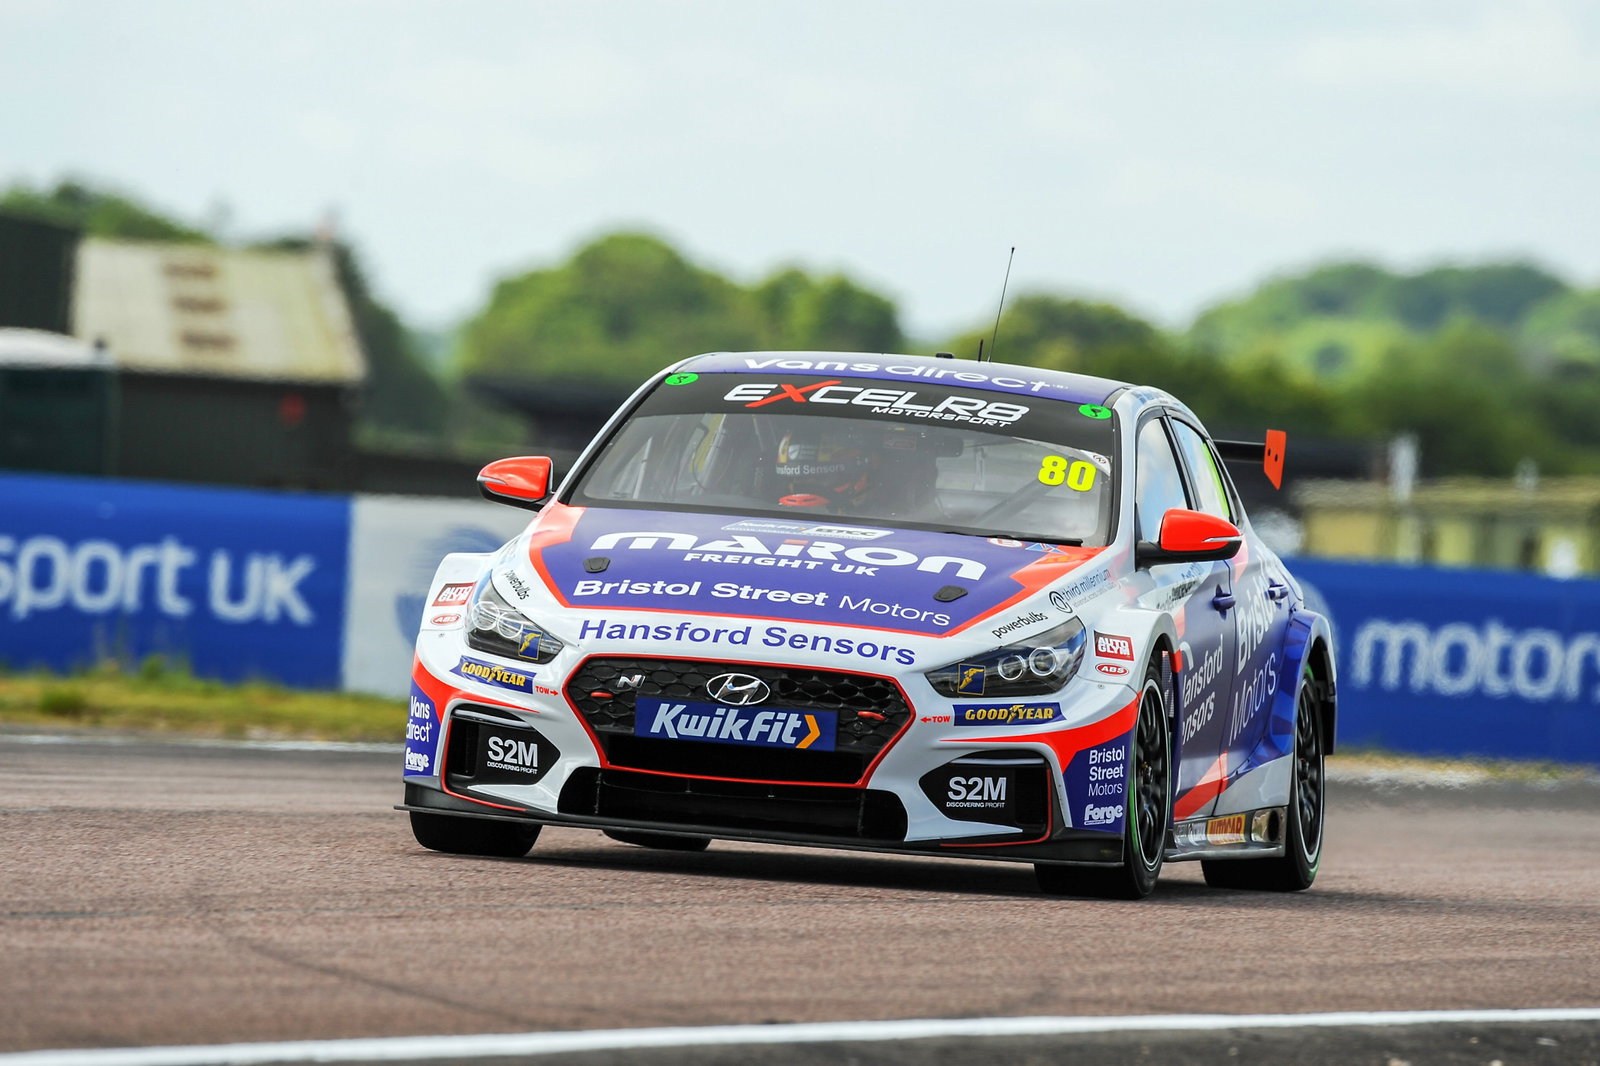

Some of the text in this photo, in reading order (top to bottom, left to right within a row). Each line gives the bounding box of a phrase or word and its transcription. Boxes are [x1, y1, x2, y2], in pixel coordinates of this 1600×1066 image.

[724, 380, 1030, 421] EXCELR8
[871, 406, 1012, 428] MOTORSPORT
[1038, 455, 1097, 493] 80
[684, 552, 880, 577] FREIGHT UK
[210, 549, 317, 626] UK
[442, 586, 473, 595] AUTO
[503, 569, 531, 601] powerbulbs
[1062, 582, 1082, 602] third
[573, 579, 951, 627] Bristol Street Motors
[992, 610, 1049, 639] powerbulbs
[579, 619, 916, 666] Hansford Sensors
[1097, 637, 1129, 649] AUTO
[1098, 645, 1131, 656] GLYM
[1100, 665, 1126, 674] ABS
[1349, 617, 1600, 704] motor
[535, 685, 550, 694] TOW
[1229, 652, 1277, 747] Motors
[411, 695, 430, 720] Vans
[932, 715, 951, 723] TOW
[487, 736, 538, 767] S2M
[1089, 746, 1125, 765] Bristol
[487, 761, 538, 774] DISCOVERING PROFIT
[1089, 764, 1124, 782] Street
[947, 777, 1007, 801] S2M
[1088, 781, 1123, 797] Motors
